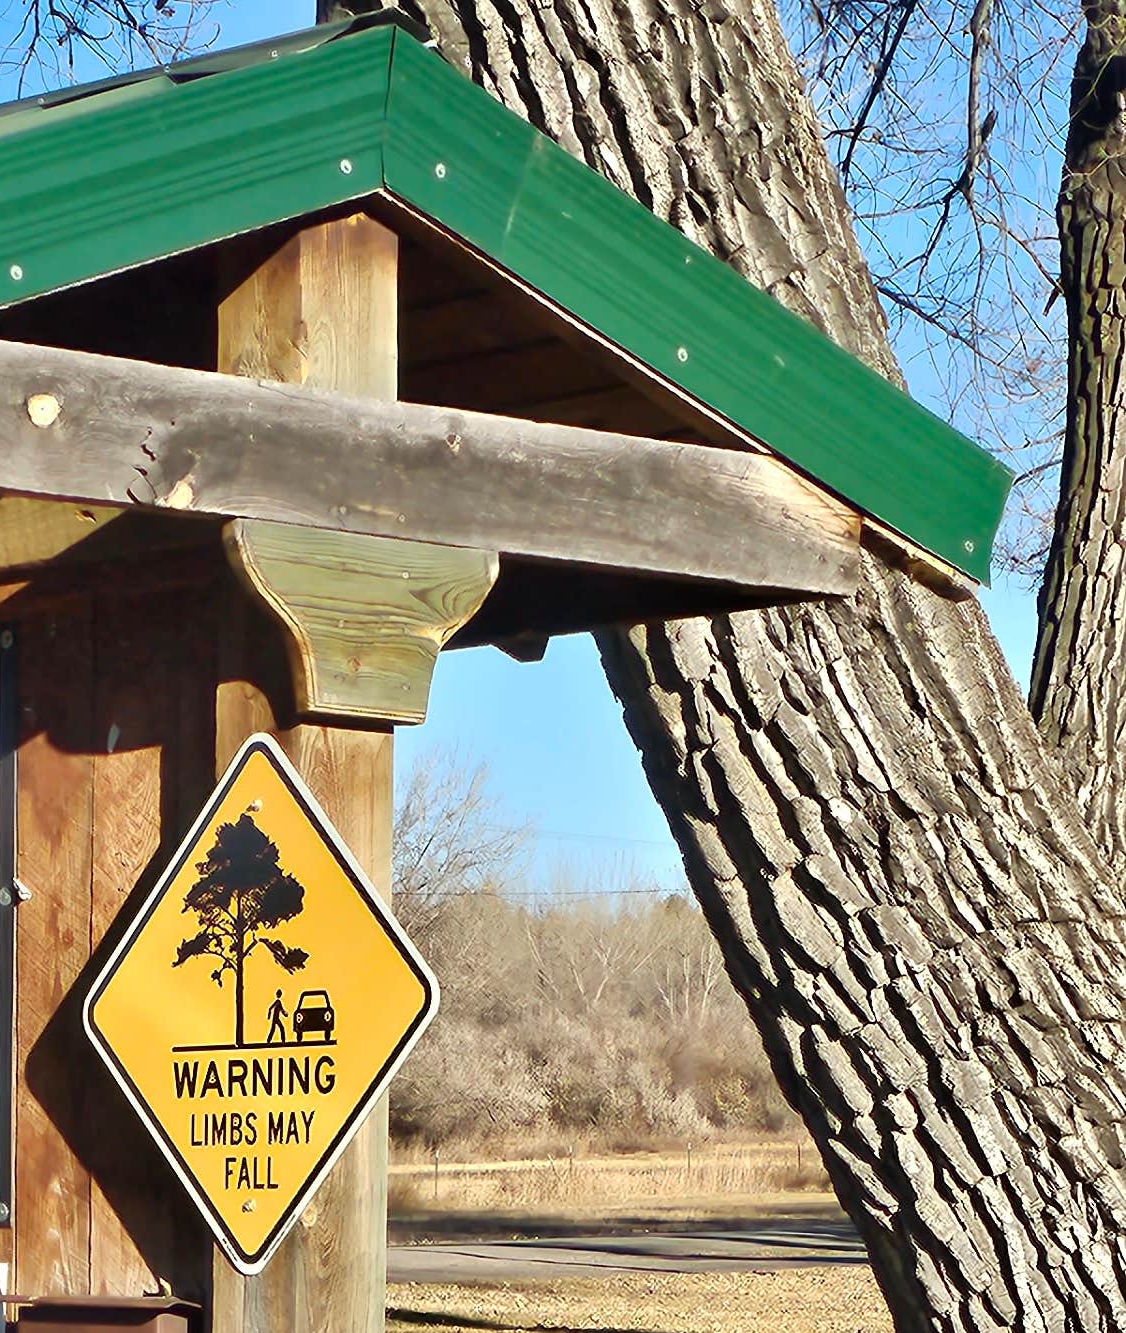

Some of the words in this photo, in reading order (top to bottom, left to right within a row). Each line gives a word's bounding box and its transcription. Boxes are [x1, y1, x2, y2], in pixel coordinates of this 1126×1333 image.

[173, 1055, 336, 1099] WARNING
[190, 1112, 258, 1147] LIMBS
[267, 1110, 315, 1145] MAY
[224, 1156, 279, 1191] FALL
